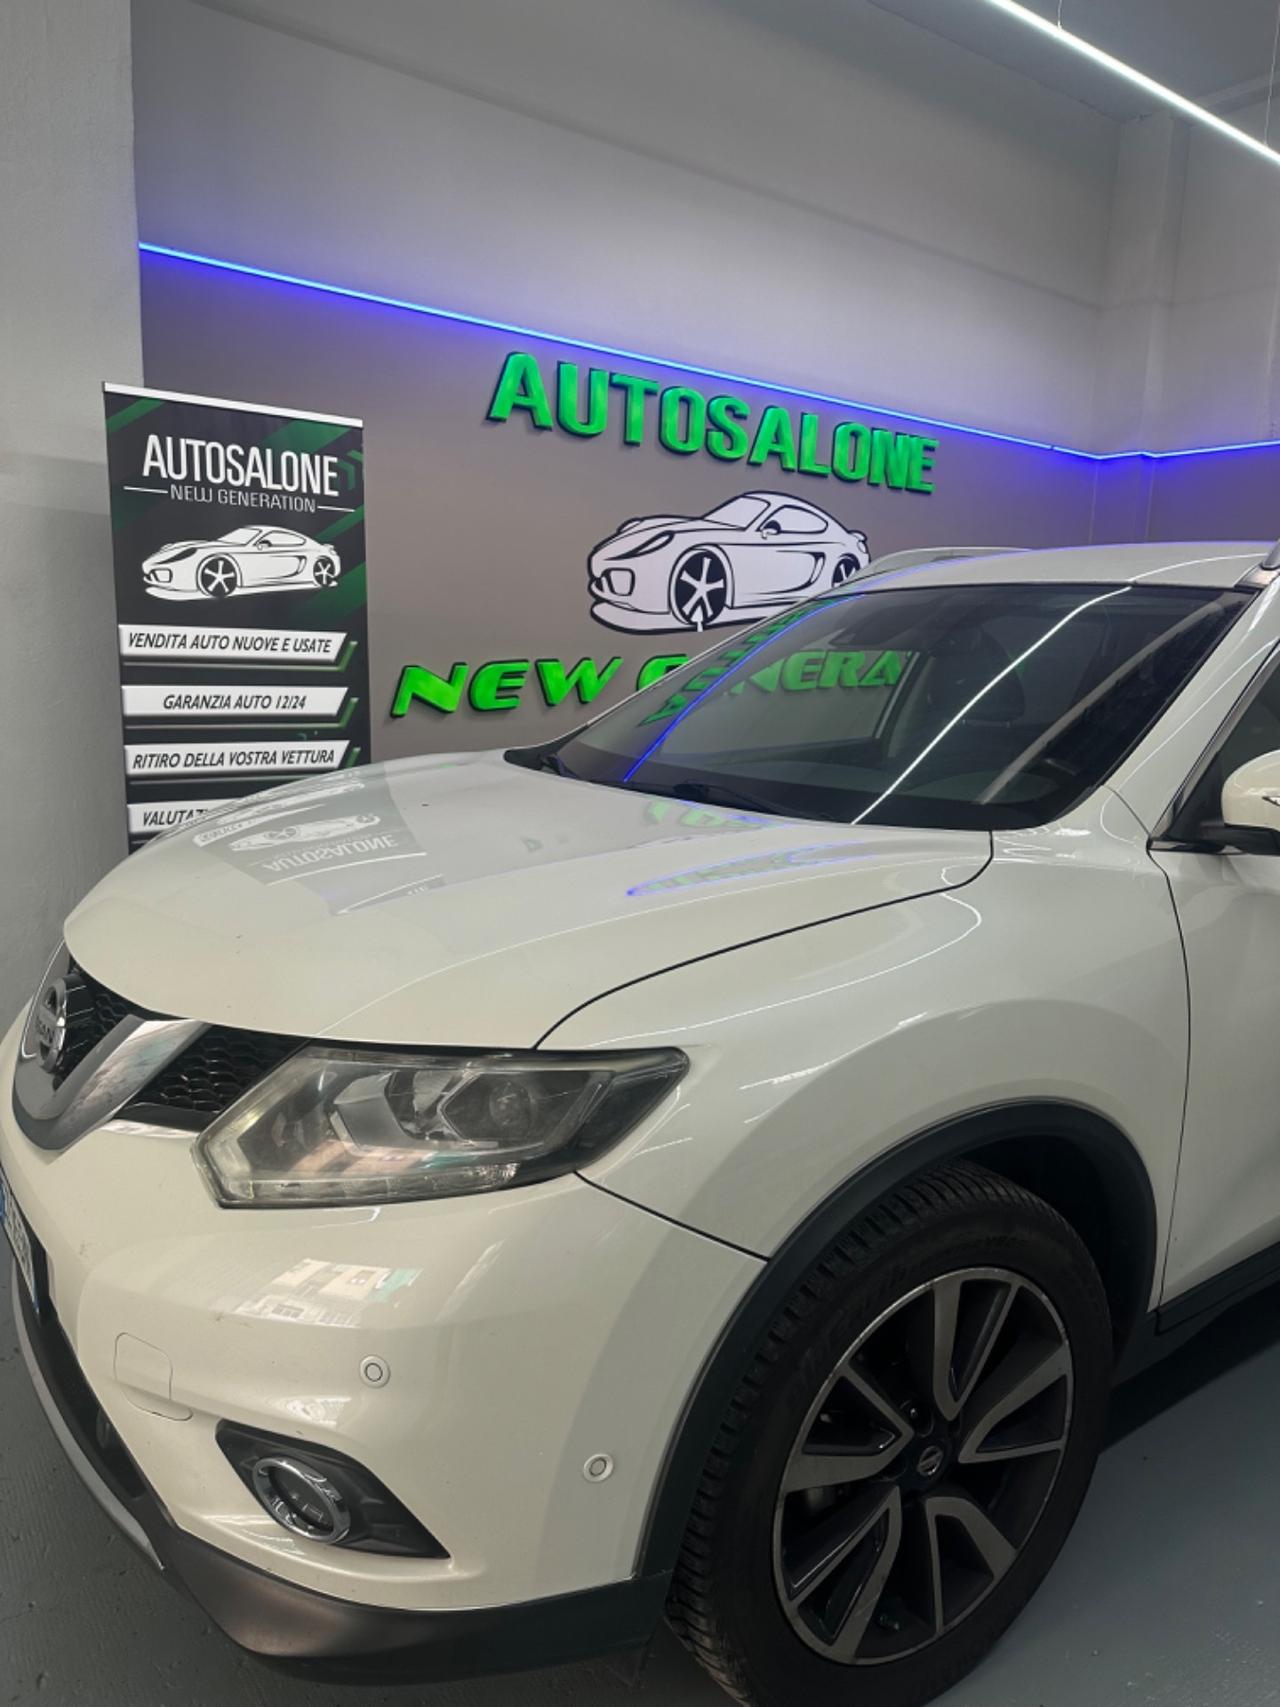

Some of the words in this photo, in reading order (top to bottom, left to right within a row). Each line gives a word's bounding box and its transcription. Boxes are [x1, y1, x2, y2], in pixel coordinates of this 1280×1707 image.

[487, 351, 938, 494] AUTOSALONE
[142, 434, 339, 497] AUTOSALONE
[170, 484, 213, 503] NEW
[217, 488, 316, 513] GENERATION
[128, 632, 187, 650] VENDITA
[190, 635, 230, 650] AUTO
[233, 636, 281, 651] NUOVE
[281, 637, 290, 652] E
[292, 638, 332, 653] USATE
[390, 656, 622, 718] NEW
[163, 694, 231, 709] GARANZIA
[233, 695, 272, 710] AUTO
[132, 754, 181, 769] RITIRO
[183, 752, 224, 767] DELLA
[229, 750, 277, 765] VOSTRA
[281, 748, 334, 764] VETTURA
[143, 809, 207, 826] VALUTA
